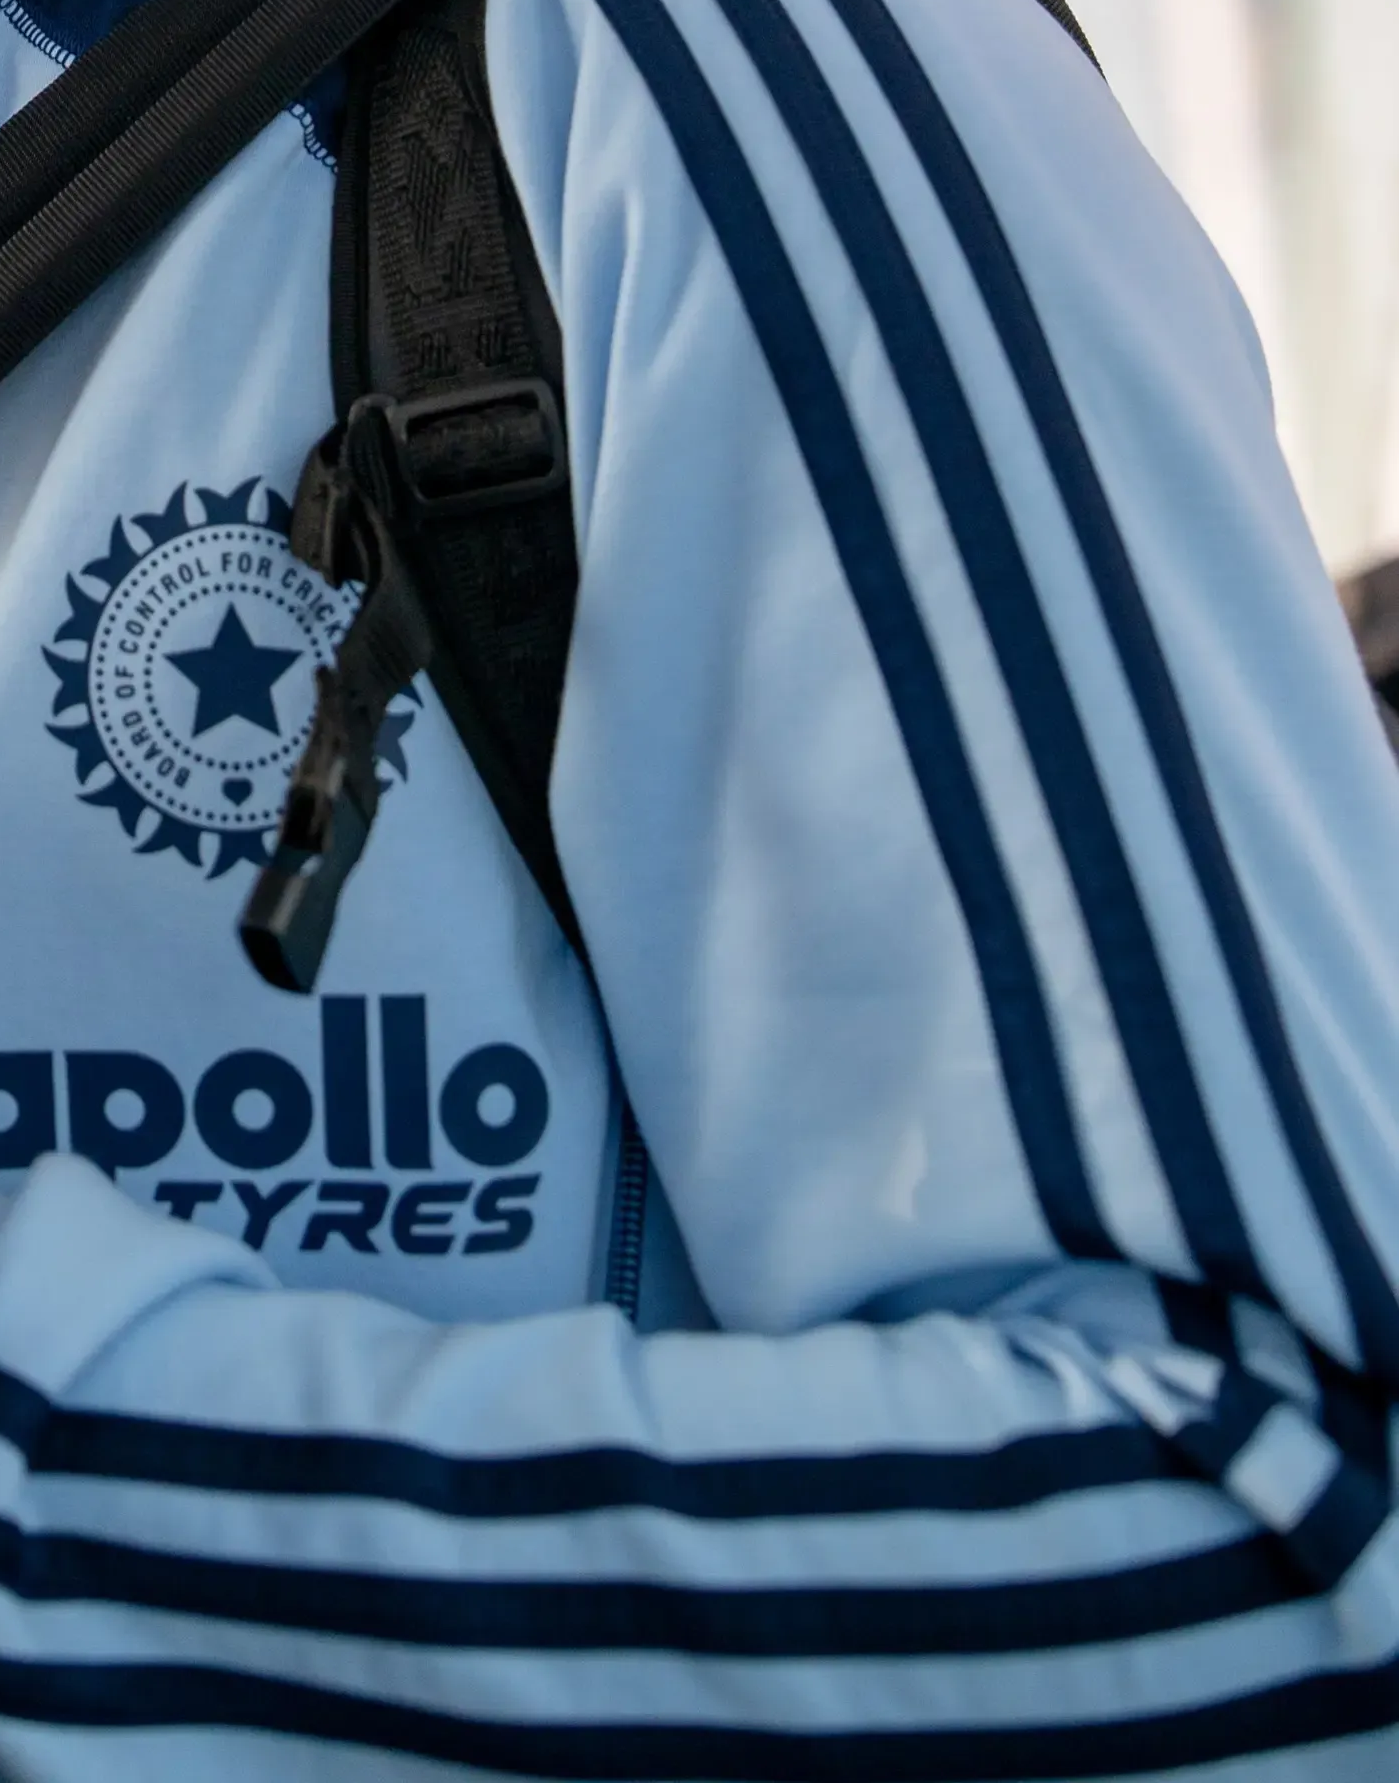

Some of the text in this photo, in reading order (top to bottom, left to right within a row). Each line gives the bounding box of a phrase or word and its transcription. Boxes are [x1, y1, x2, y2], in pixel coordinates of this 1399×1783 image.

[114, 551, 346, 789] BOARD OF CONTROL FOR CRICK
[152, 1172, 543, 1256] TYRES
